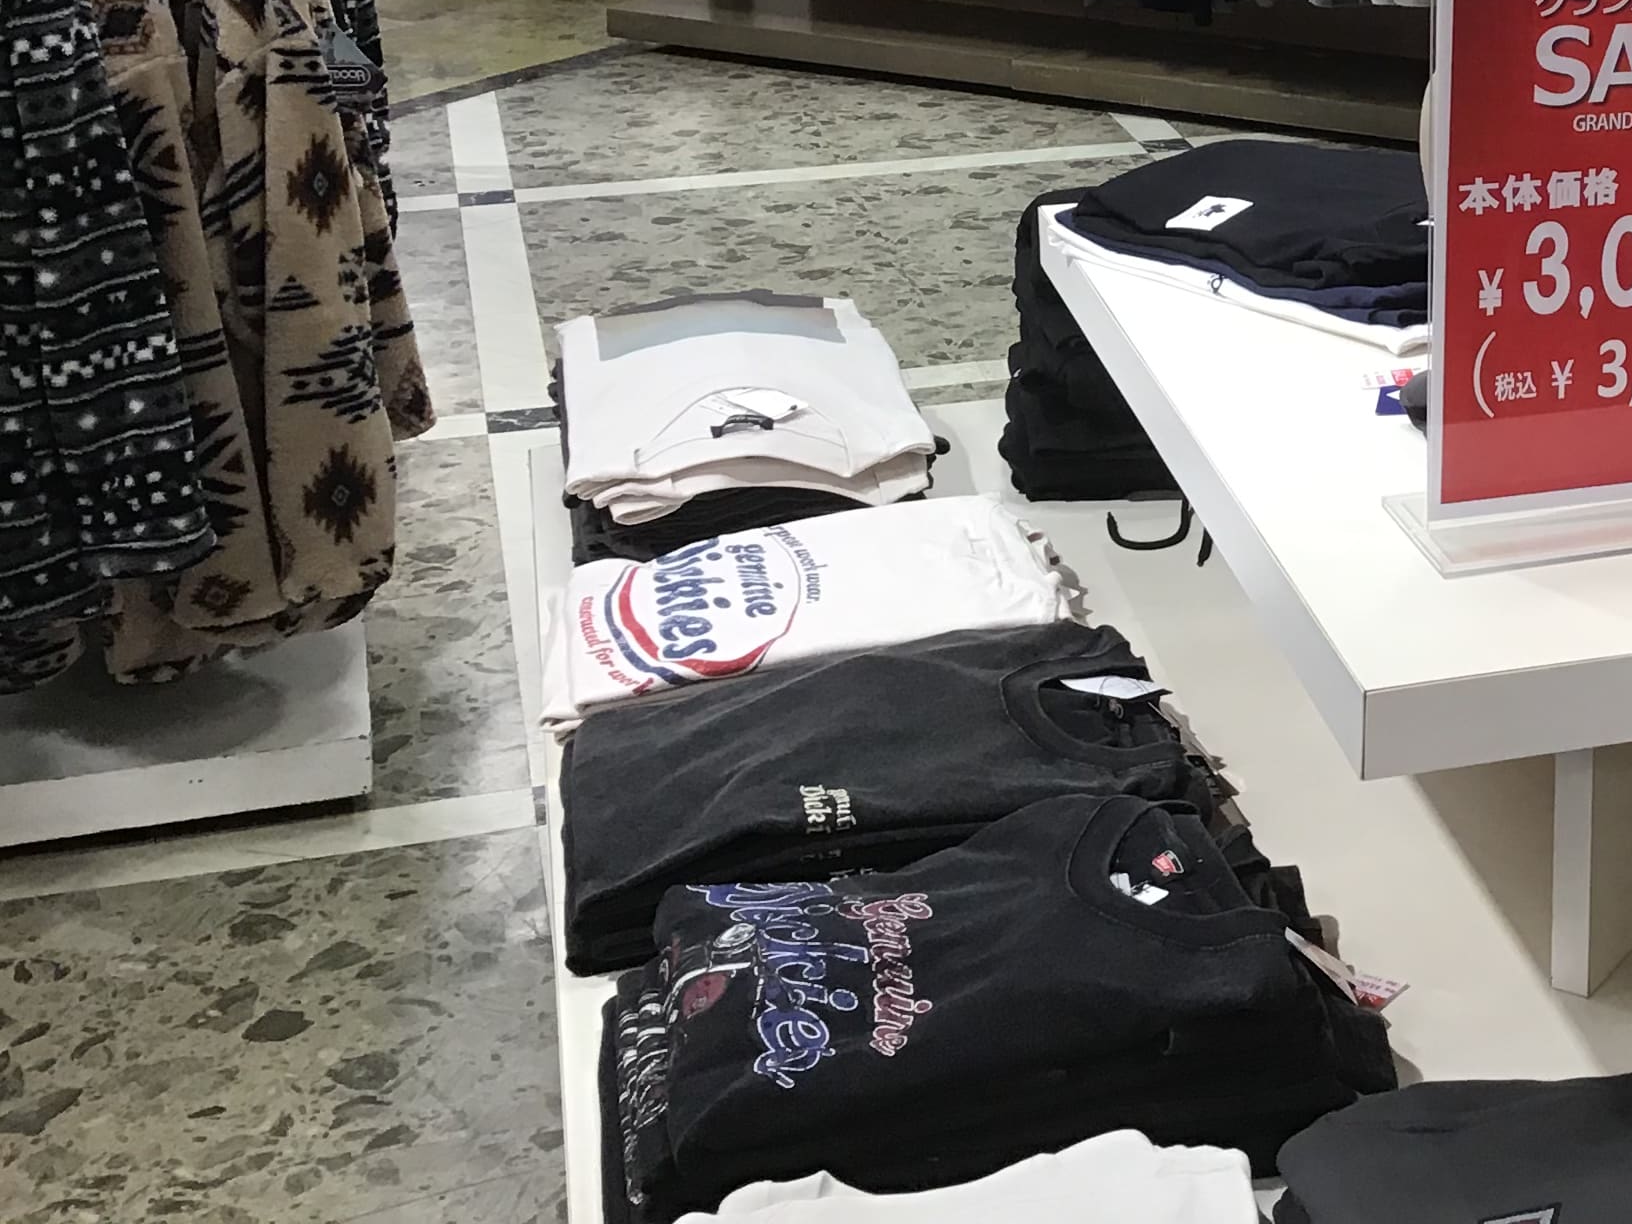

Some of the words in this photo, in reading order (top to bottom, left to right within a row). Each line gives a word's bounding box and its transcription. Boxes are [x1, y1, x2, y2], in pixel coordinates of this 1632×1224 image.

[1458, 167, 1619, 216] 本体価格
[585, 639, 616, 668] for
[835, 893, 933, 1057] Genuine
